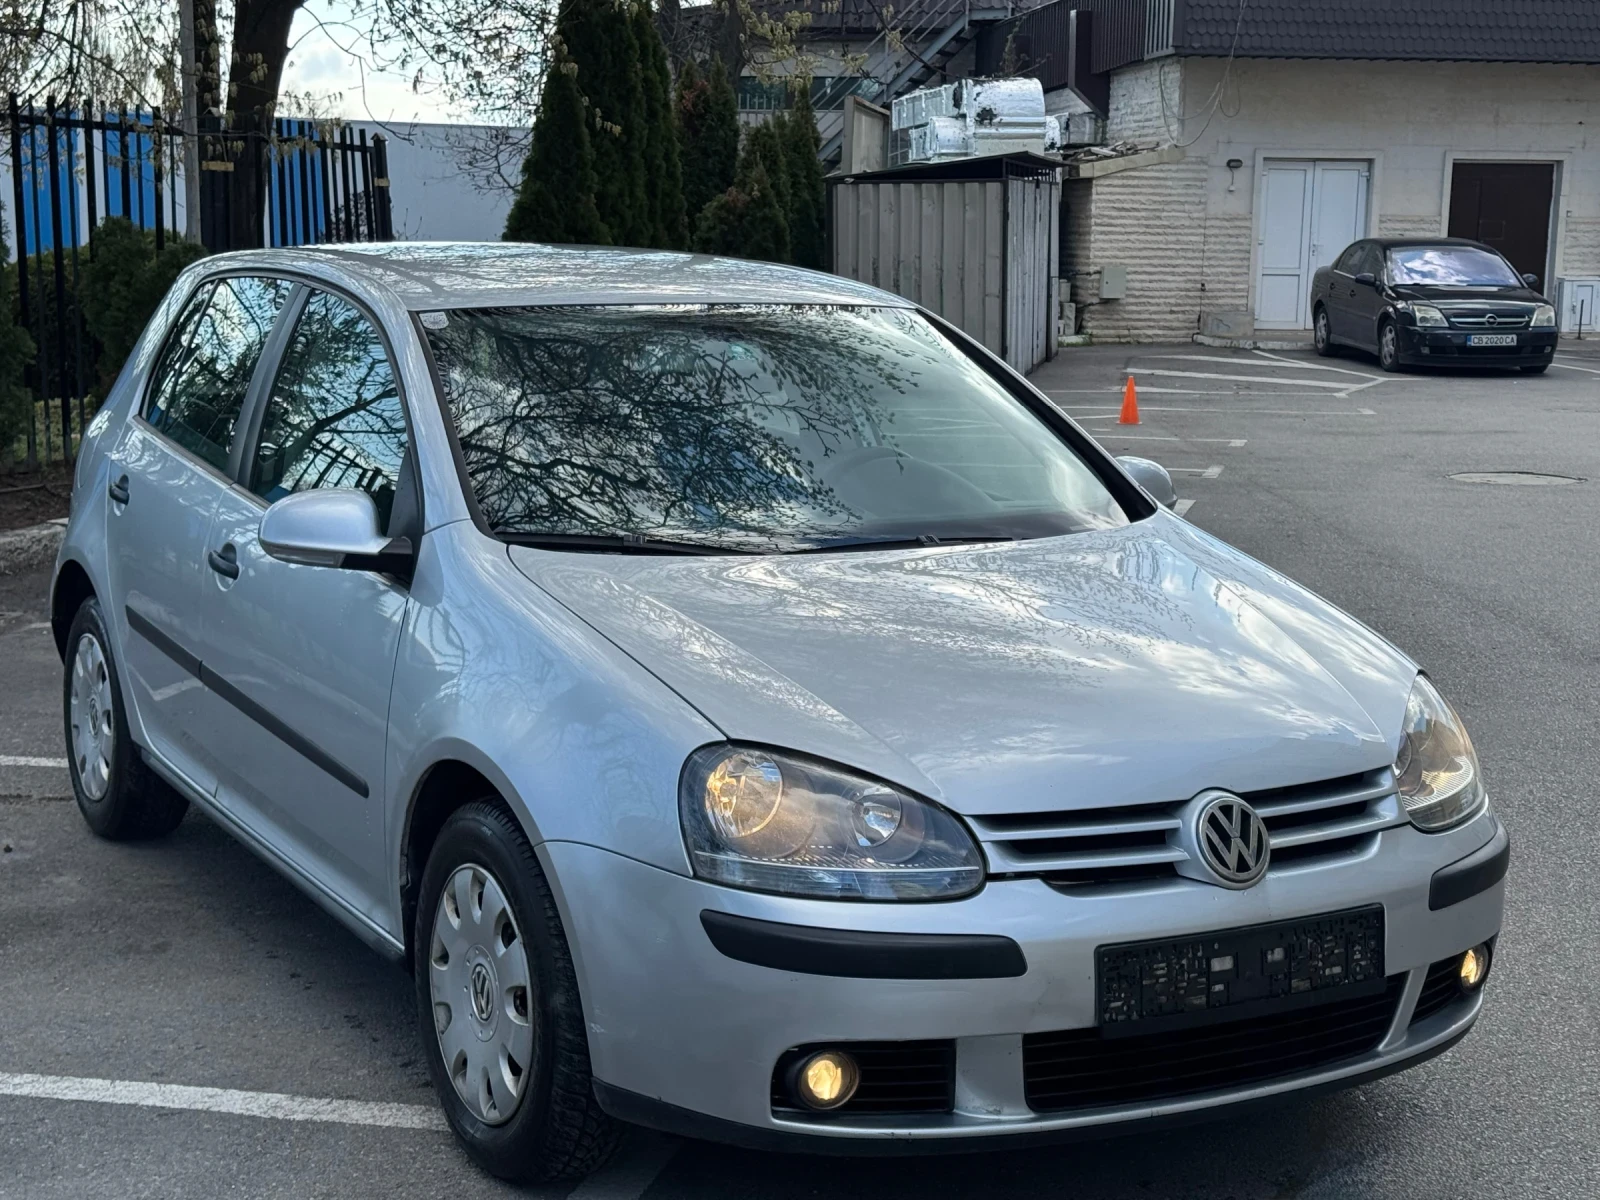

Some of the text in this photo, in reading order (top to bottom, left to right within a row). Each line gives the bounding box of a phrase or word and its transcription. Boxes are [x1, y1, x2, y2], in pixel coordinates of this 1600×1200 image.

[1472, 336, 1515, 345] CB 2020 CA
